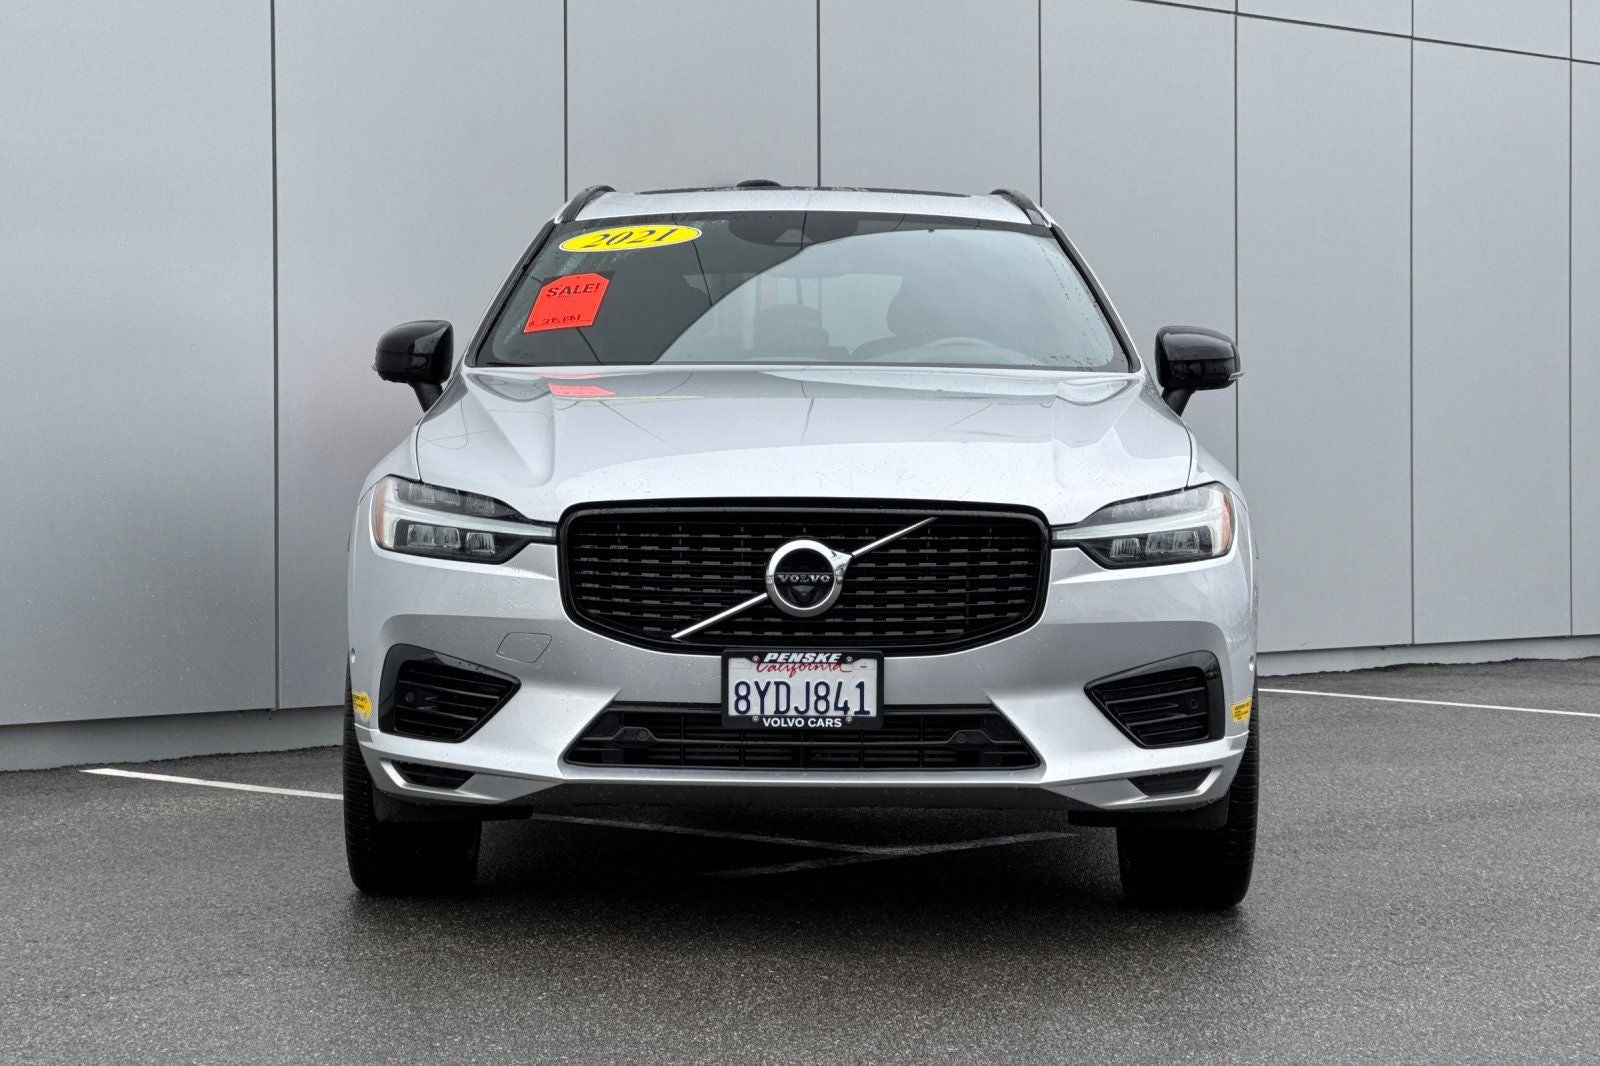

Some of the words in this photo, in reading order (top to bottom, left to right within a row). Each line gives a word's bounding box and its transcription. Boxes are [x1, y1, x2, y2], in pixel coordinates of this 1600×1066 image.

[581, 228, 679, 249] 2021
[546, 283, 600, 297] SALE!
[777, 574, 830, 583] VOLVO
[763, 652, 842, 663] PENSKE
[755, 661, 852, 678] California
[734, 680, 870, 715] 8YDJ841
[763, 718, 804, 727] VOLVO
[808, 718, 842, 727] CARS
